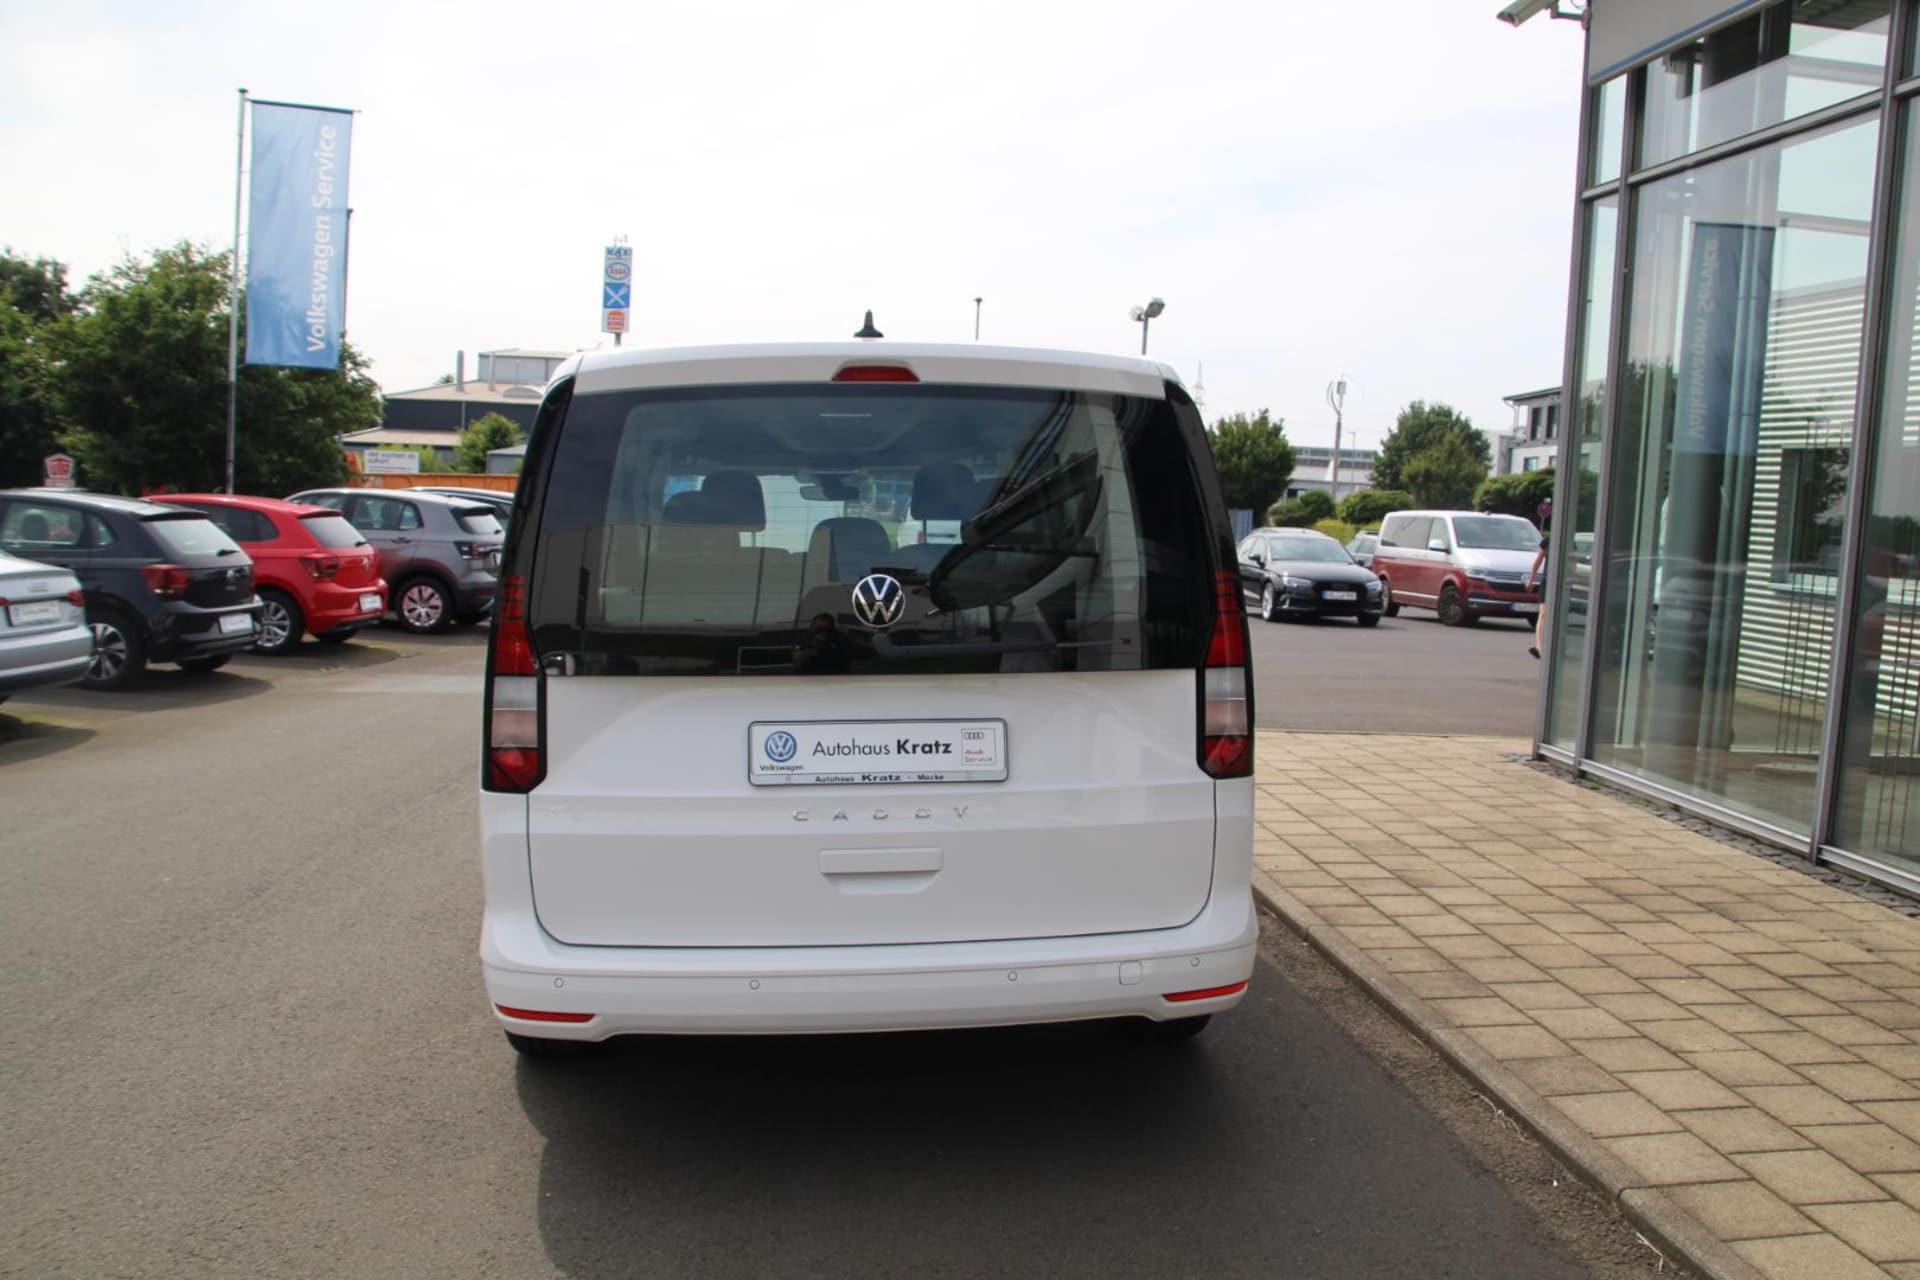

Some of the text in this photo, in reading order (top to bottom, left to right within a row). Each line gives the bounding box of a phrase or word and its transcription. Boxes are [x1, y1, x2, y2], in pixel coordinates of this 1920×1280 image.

[306, 125, 336, 352] Volkswagen Service
[812, 737, 953, 757] Autohaus Kratz
[760, 764, 804, 772] Volkswagen
[815, 775, 854, 783] Autohaus
[861, 774, 901, 782] Kratz
[792, 806, 969, 822] CADDY
